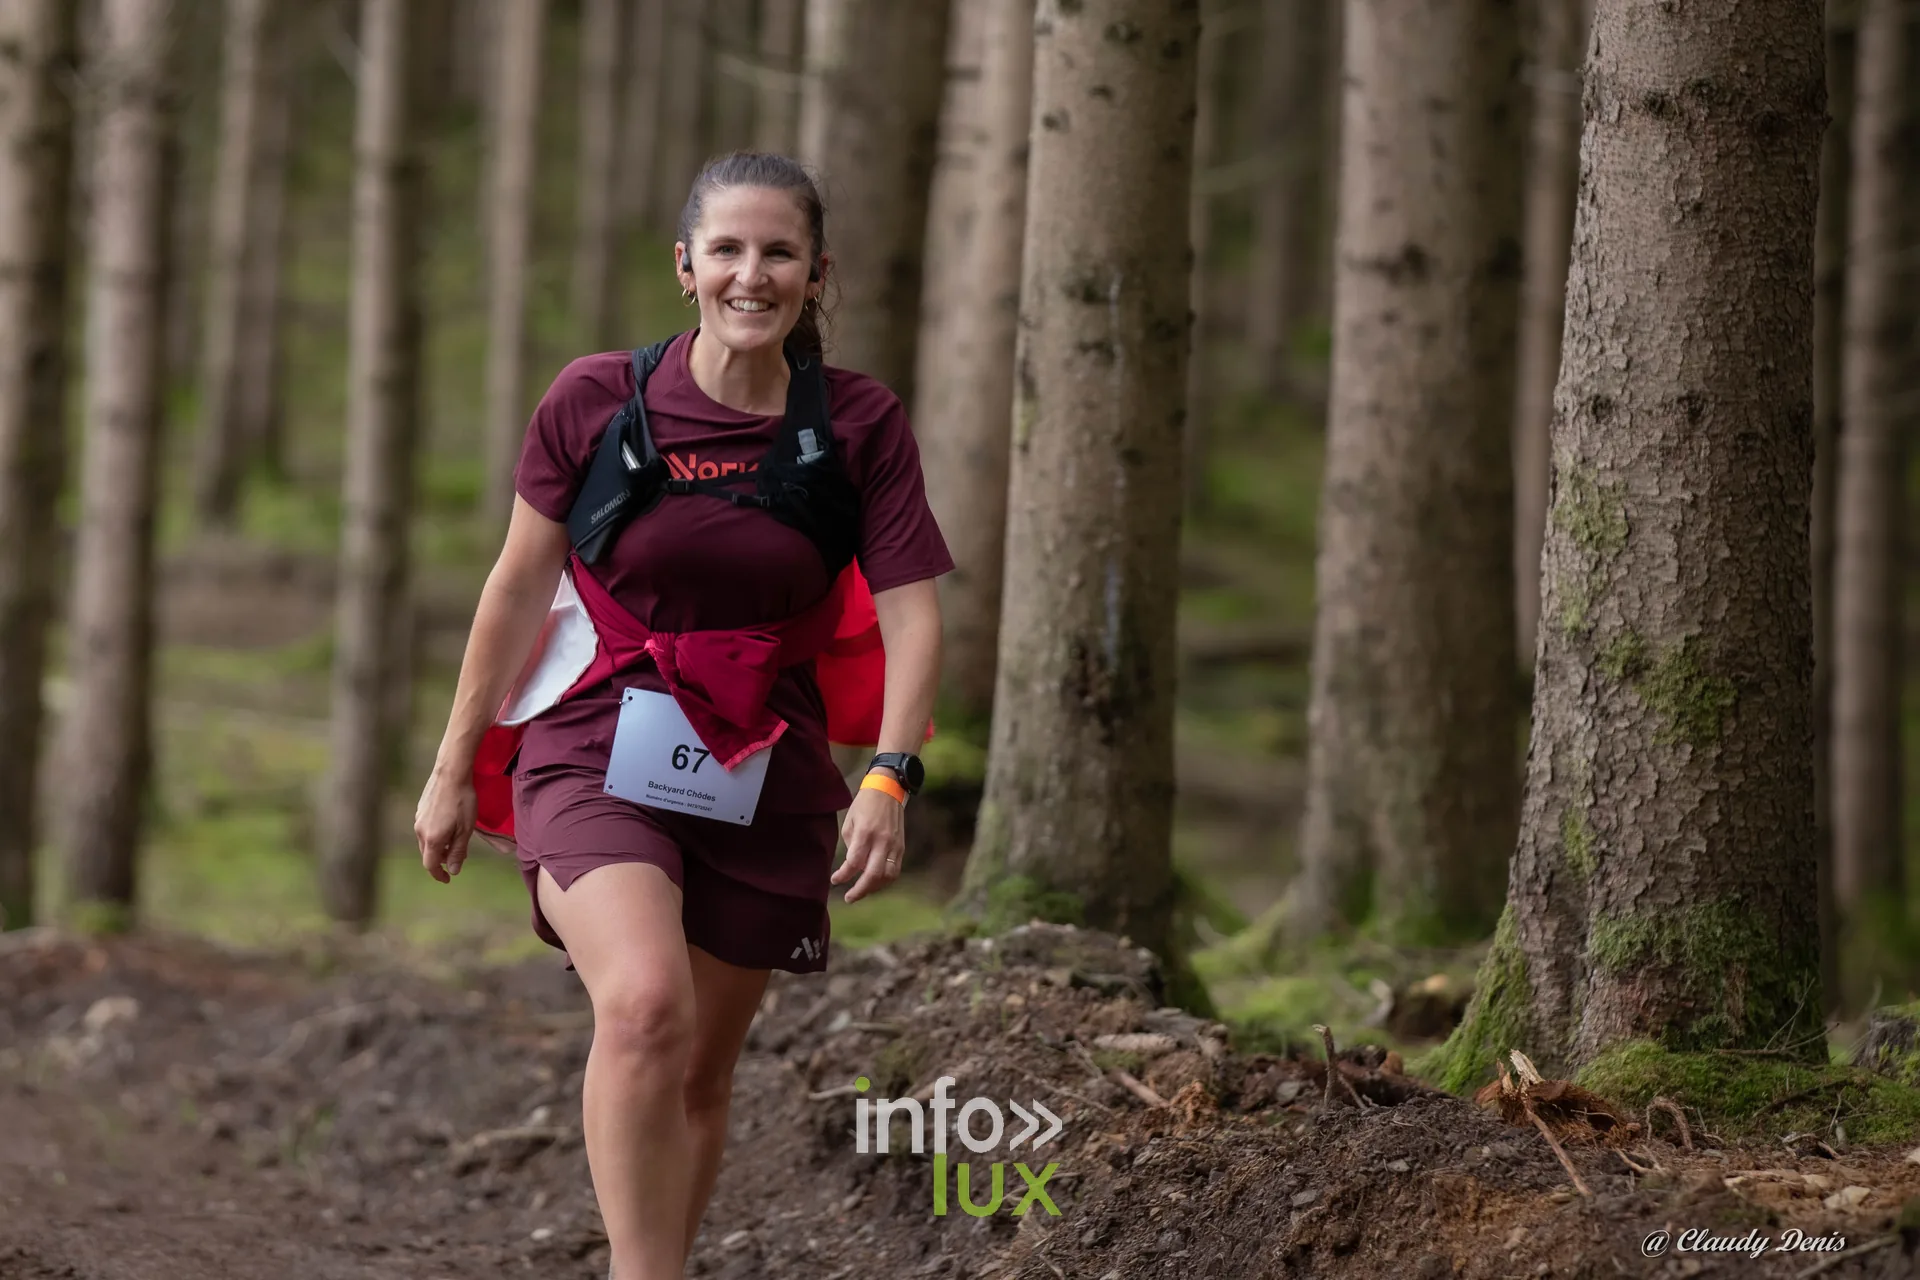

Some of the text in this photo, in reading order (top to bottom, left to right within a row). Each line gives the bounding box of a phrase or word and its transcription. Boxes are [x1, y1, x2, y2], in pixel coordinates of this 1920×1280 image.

[591, 488, 631, 525] SALOMON
[671, 744, 710, 774] 67
[648, 781, 685, 795] Backyard
